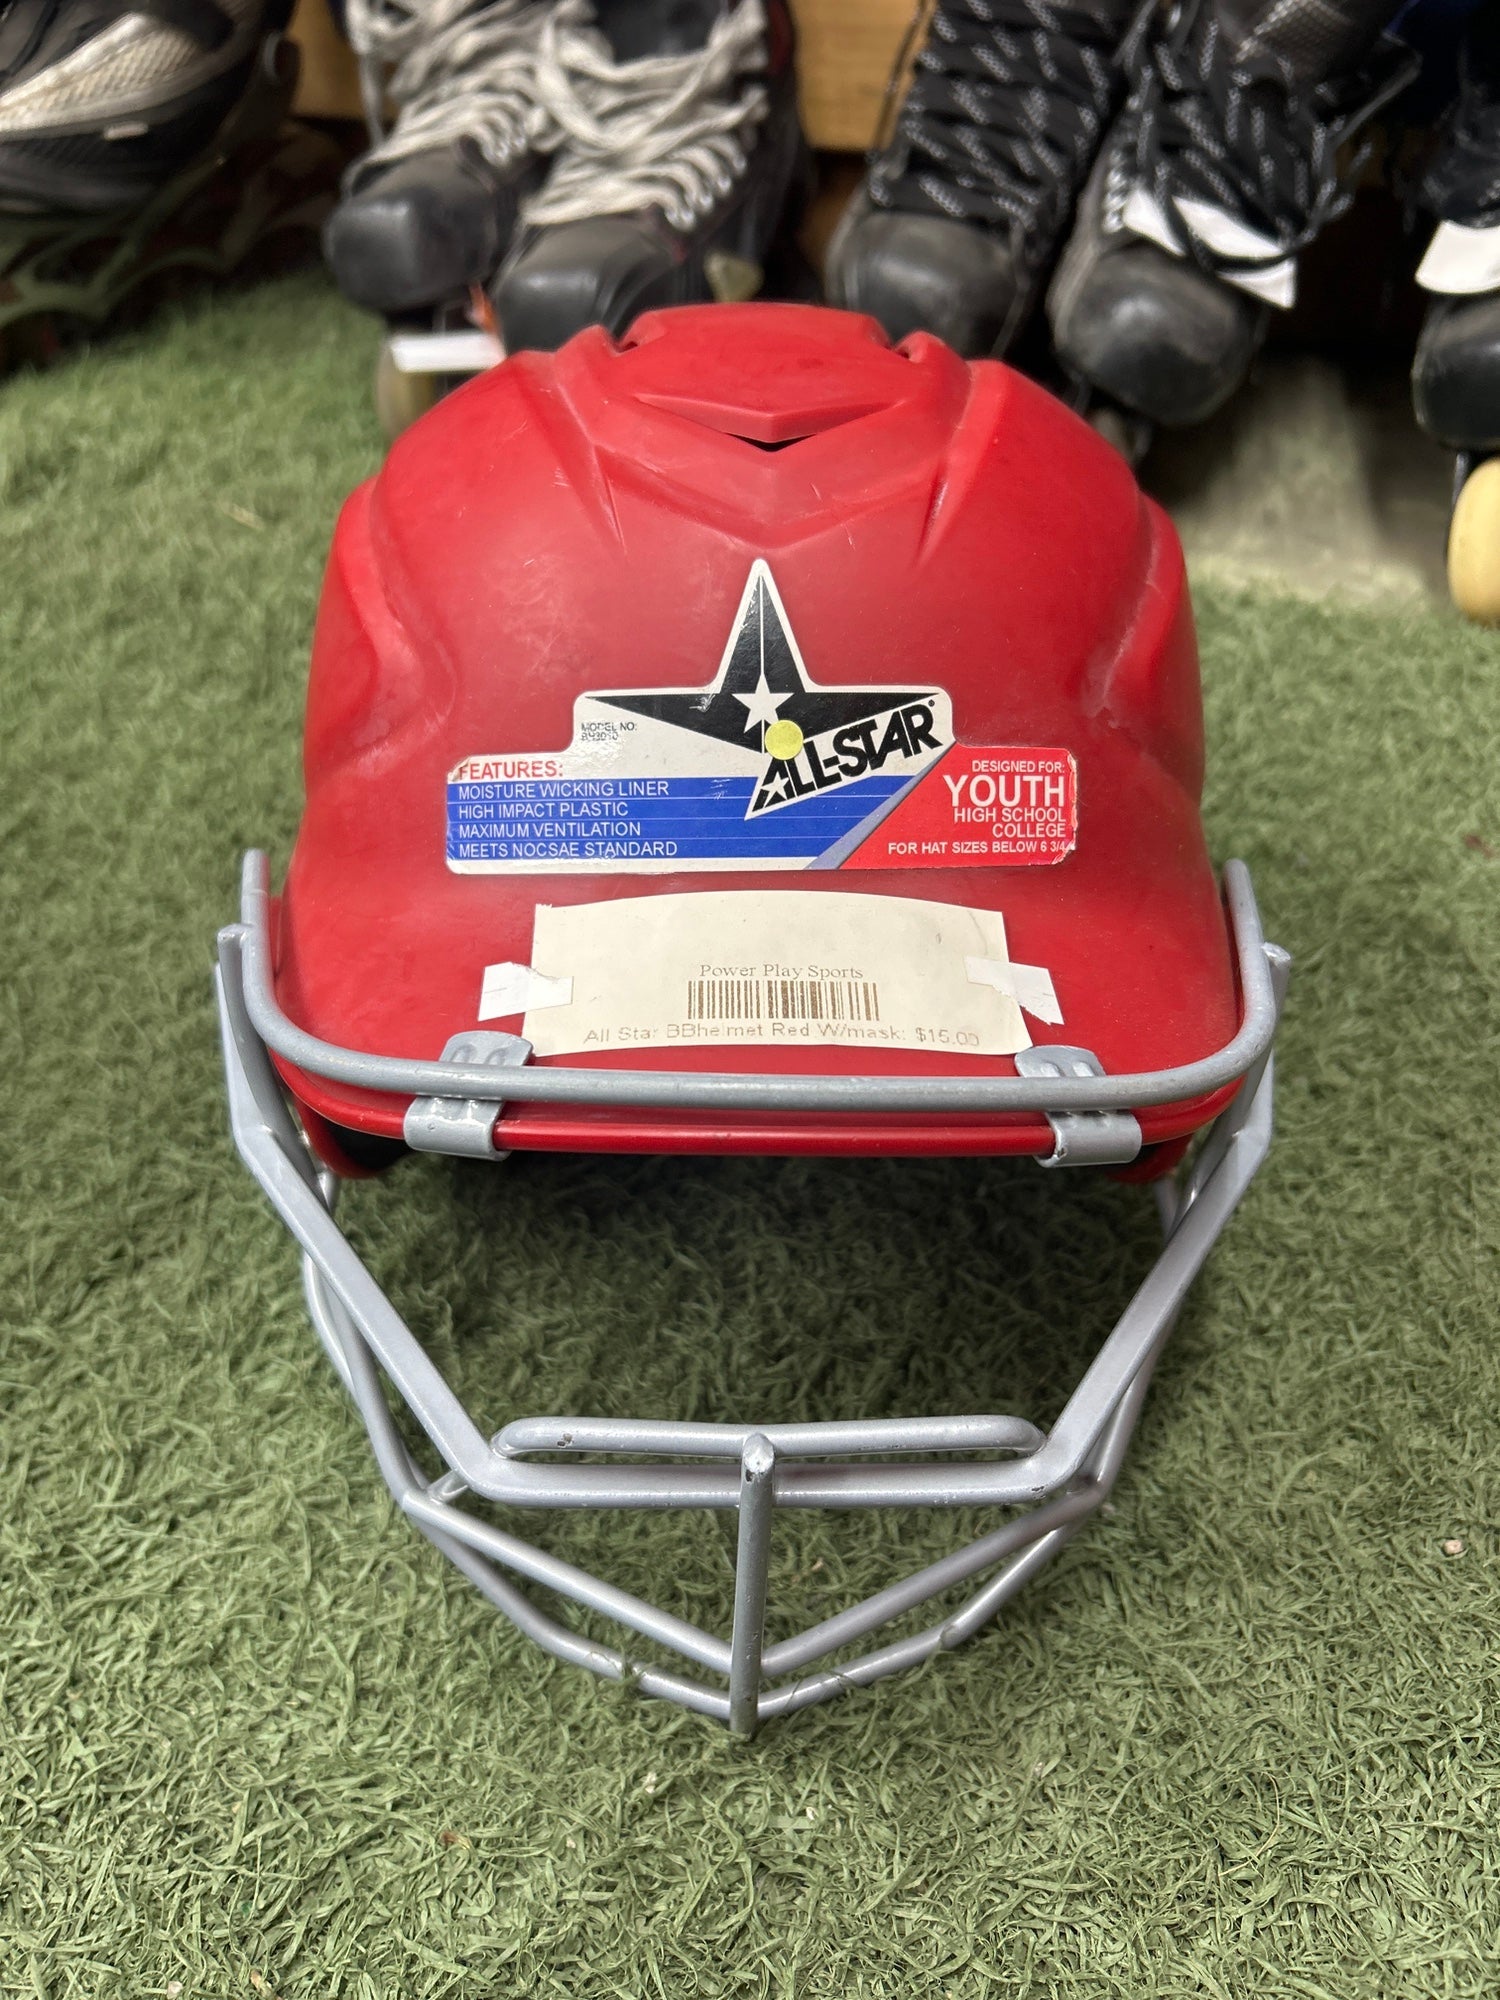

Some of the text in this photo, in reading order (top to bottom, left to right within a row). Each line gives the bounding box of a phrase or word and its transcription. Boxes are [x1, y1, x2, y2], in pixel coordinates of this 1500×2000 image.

[581, 722, 638, 732] MODEL NO:
[752, 703, 944, 813] ALL-STAR
[458, 761, 564, 781] FEATURES:
[971, 760, 1066, 774] DESIGNED FOR:
[458, 780, 670, 800] MOISTURE WICKING LINER
[942, 774, 1066, 808] YOUTH
[458, 801, 629, 818] HIGH IMPACT PLASTIC
[953, 807, 1067, 823] HIGH SCHOOL
[458, 821, 642, 839] MAXIMUM VENTILATION
[991, 823, 1067, 839] COLLEGE
[458, 841, 678, 859] MEETS NOCSAE STANDARD
[888, 841, 1066, 855] FOR HAT SIZES BELOW 6 3/4
[699, 964, 864, 981] Power Play Sports
[583, 1028, 610, 1044] All
[771, 1022, 810, 1037] Red
[817, 1023, 906, 1040] W/mask:
[915, 1026, 981, 1047] $15.00
